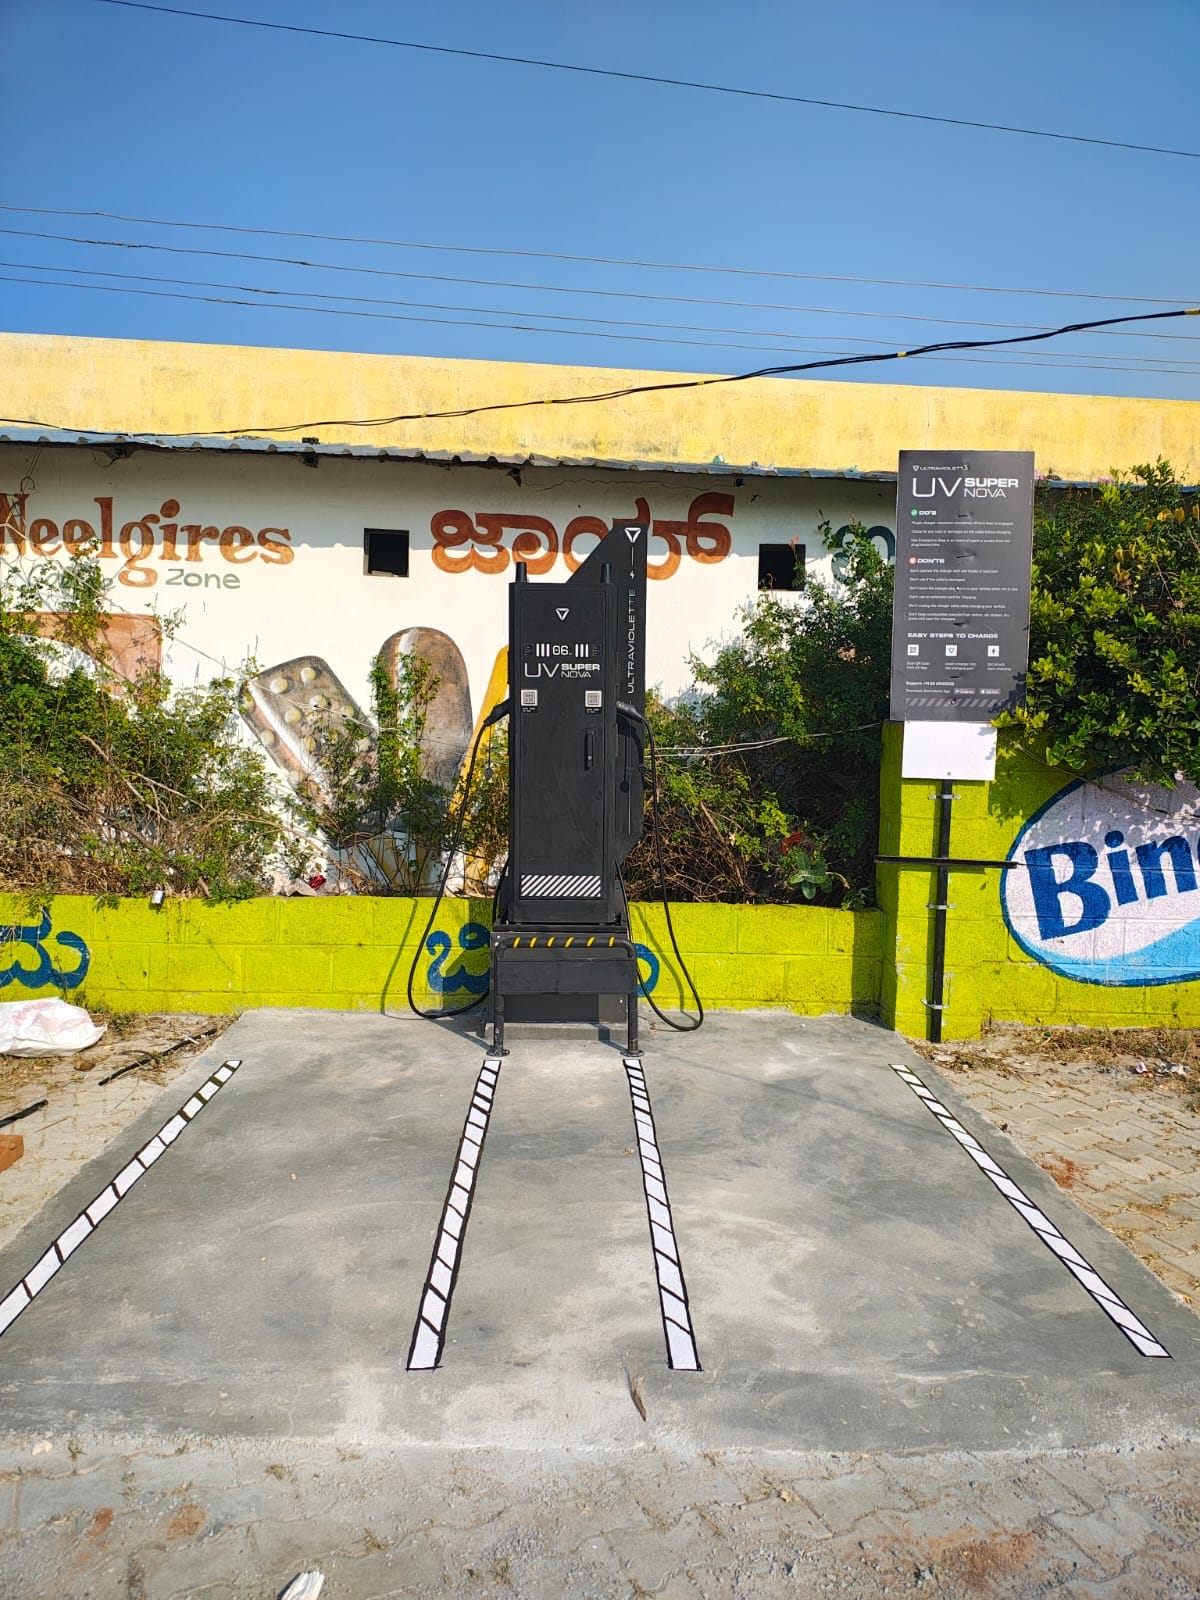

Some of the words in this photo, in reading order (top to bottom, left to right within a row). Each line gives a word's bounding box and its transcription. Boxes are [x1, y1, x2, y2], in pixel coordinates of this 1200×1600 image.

[912, 477, 962, 498] UV
[964, 477, 1020, 488] SUPER
[963, 488, 1008, 498] NOVA
[0, 492, 295, 588] Neelgires
[165, 568, 241, 590] Zone
[627, 588, 636, 695] ULTRAVIOLETTE
[524, 662, 560, 678] UV
[561, 663, 601, 671] SUPER
[561, 671, 592, 679] NOVA
[1024, 830, 1200, 940] Bin
